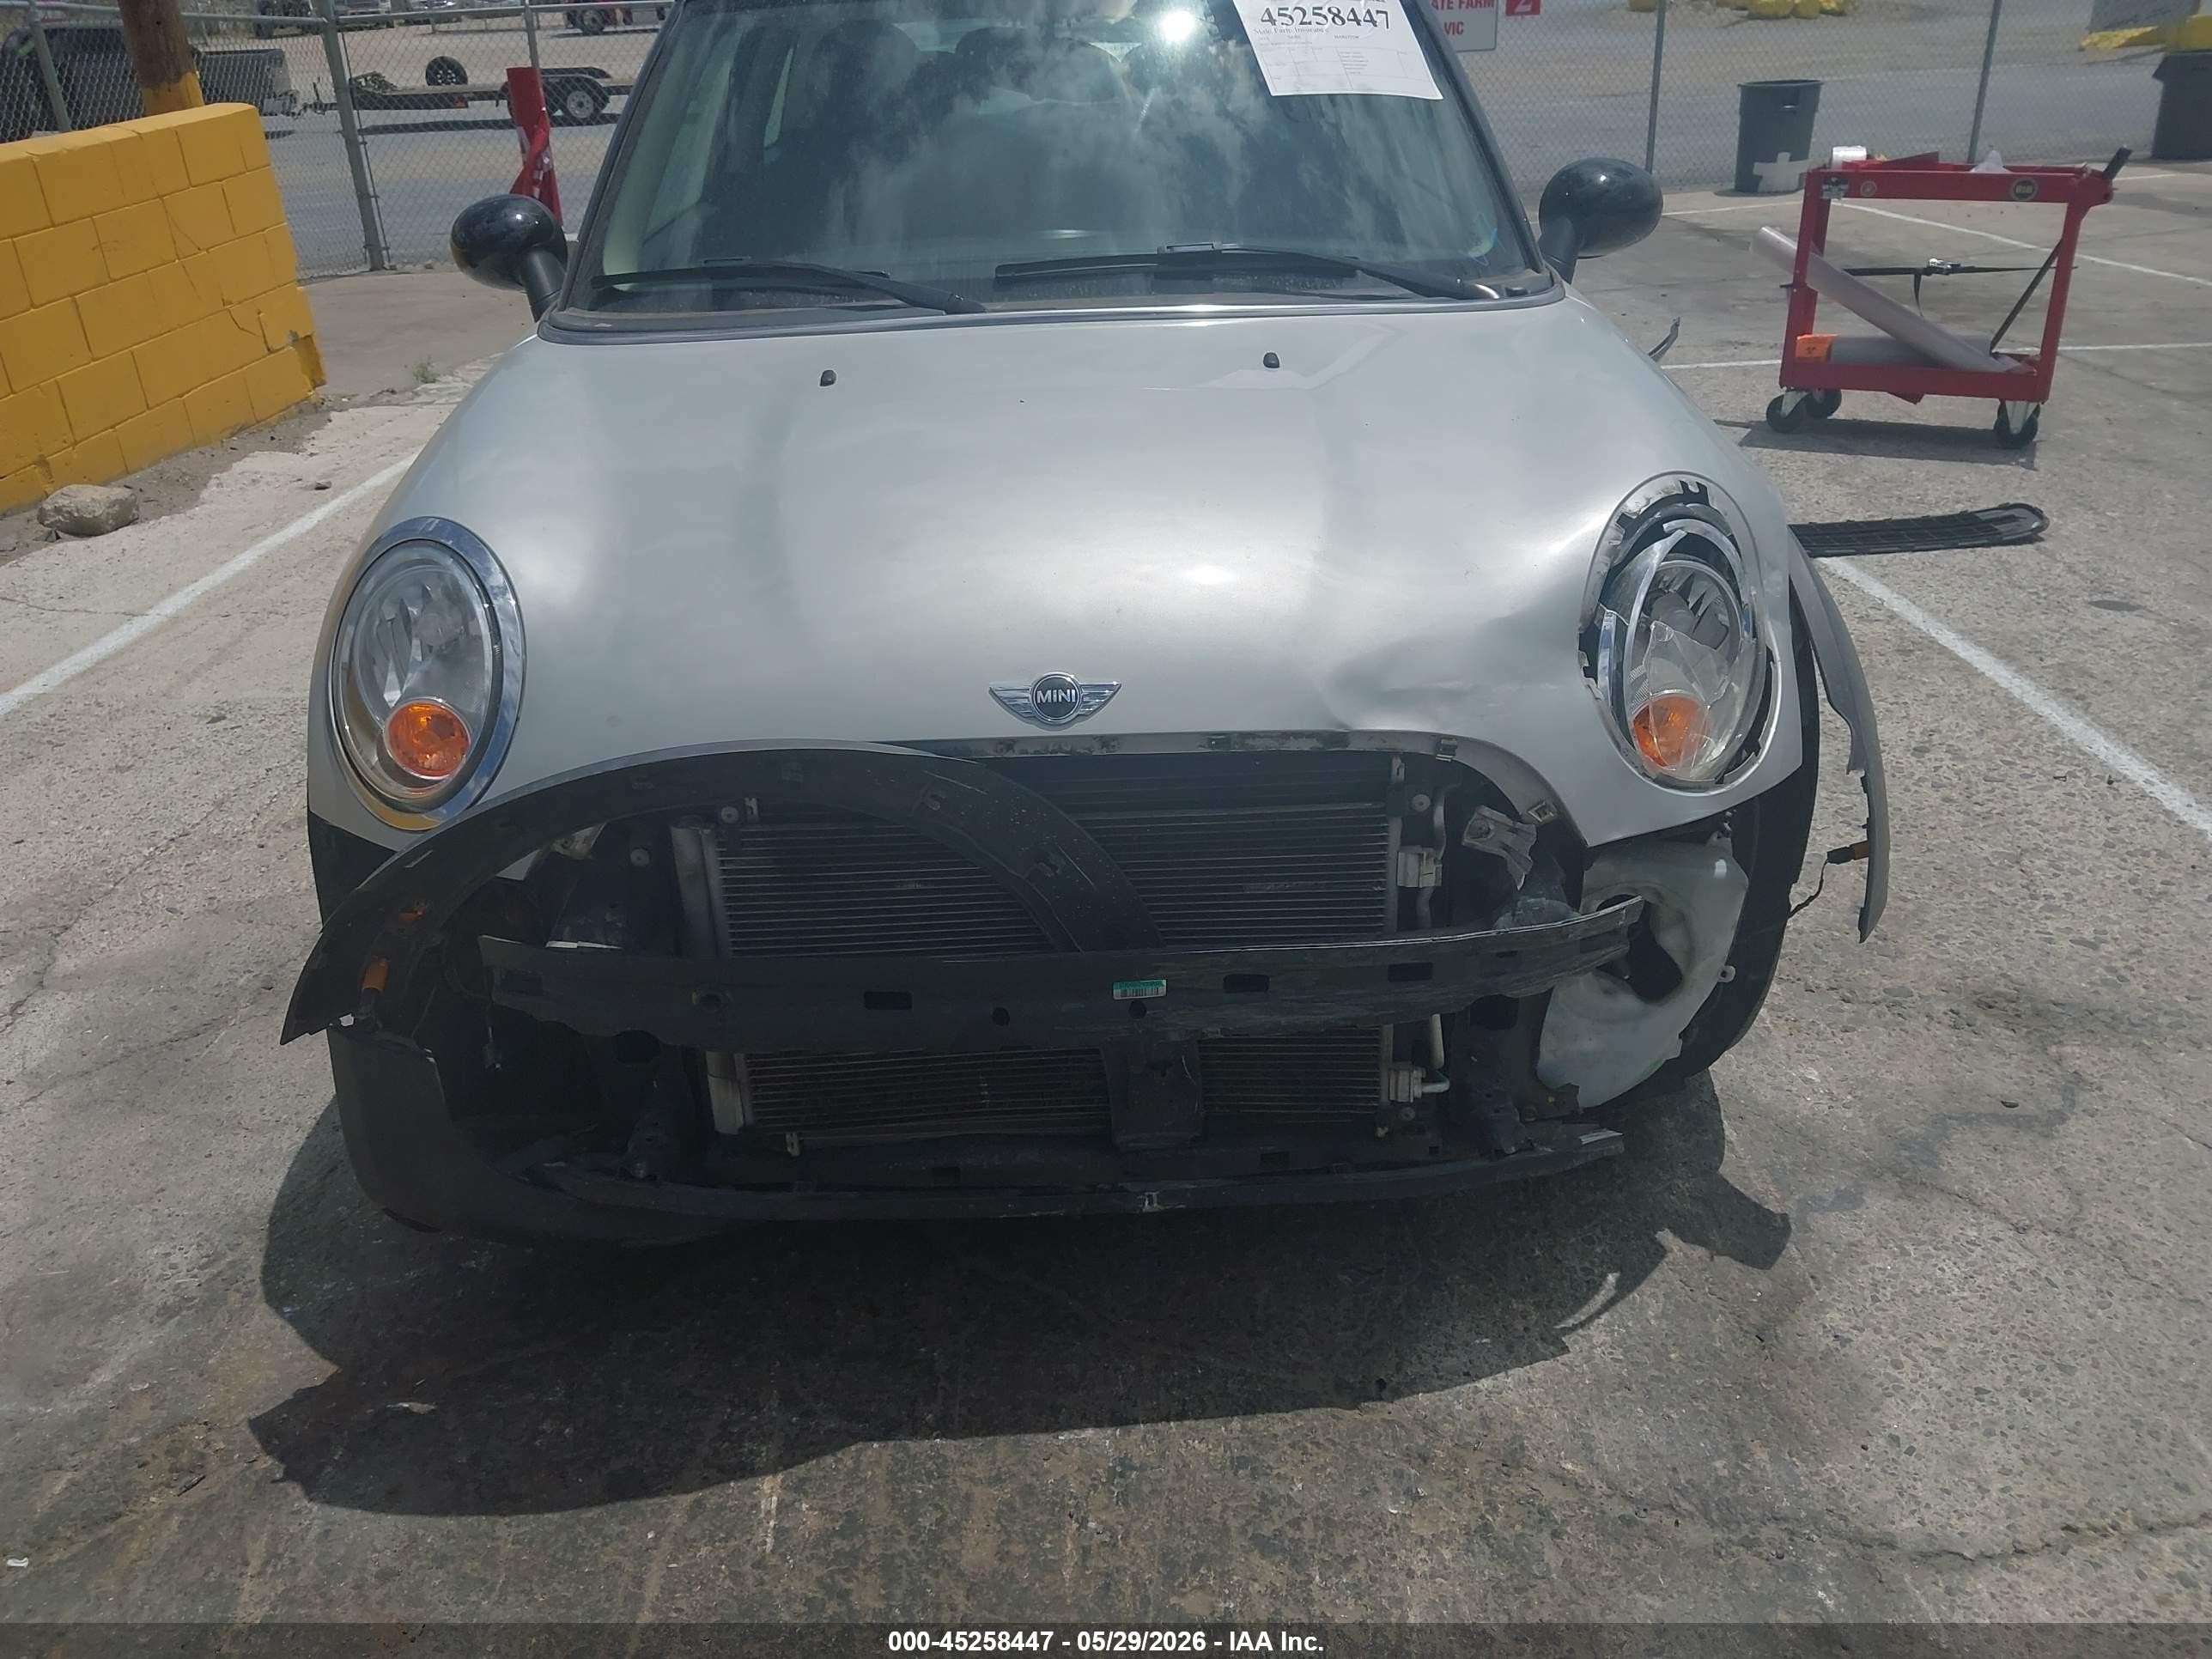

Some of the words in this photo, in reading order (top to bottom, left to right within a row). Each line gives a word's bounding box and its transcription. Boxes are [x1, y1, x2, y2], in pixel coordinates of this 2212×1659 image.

[1261, 7, 1389, 29] 45258447
[1444, 21, 1464, 35] VIC
[1036, 689, 1076, 703] MINI
